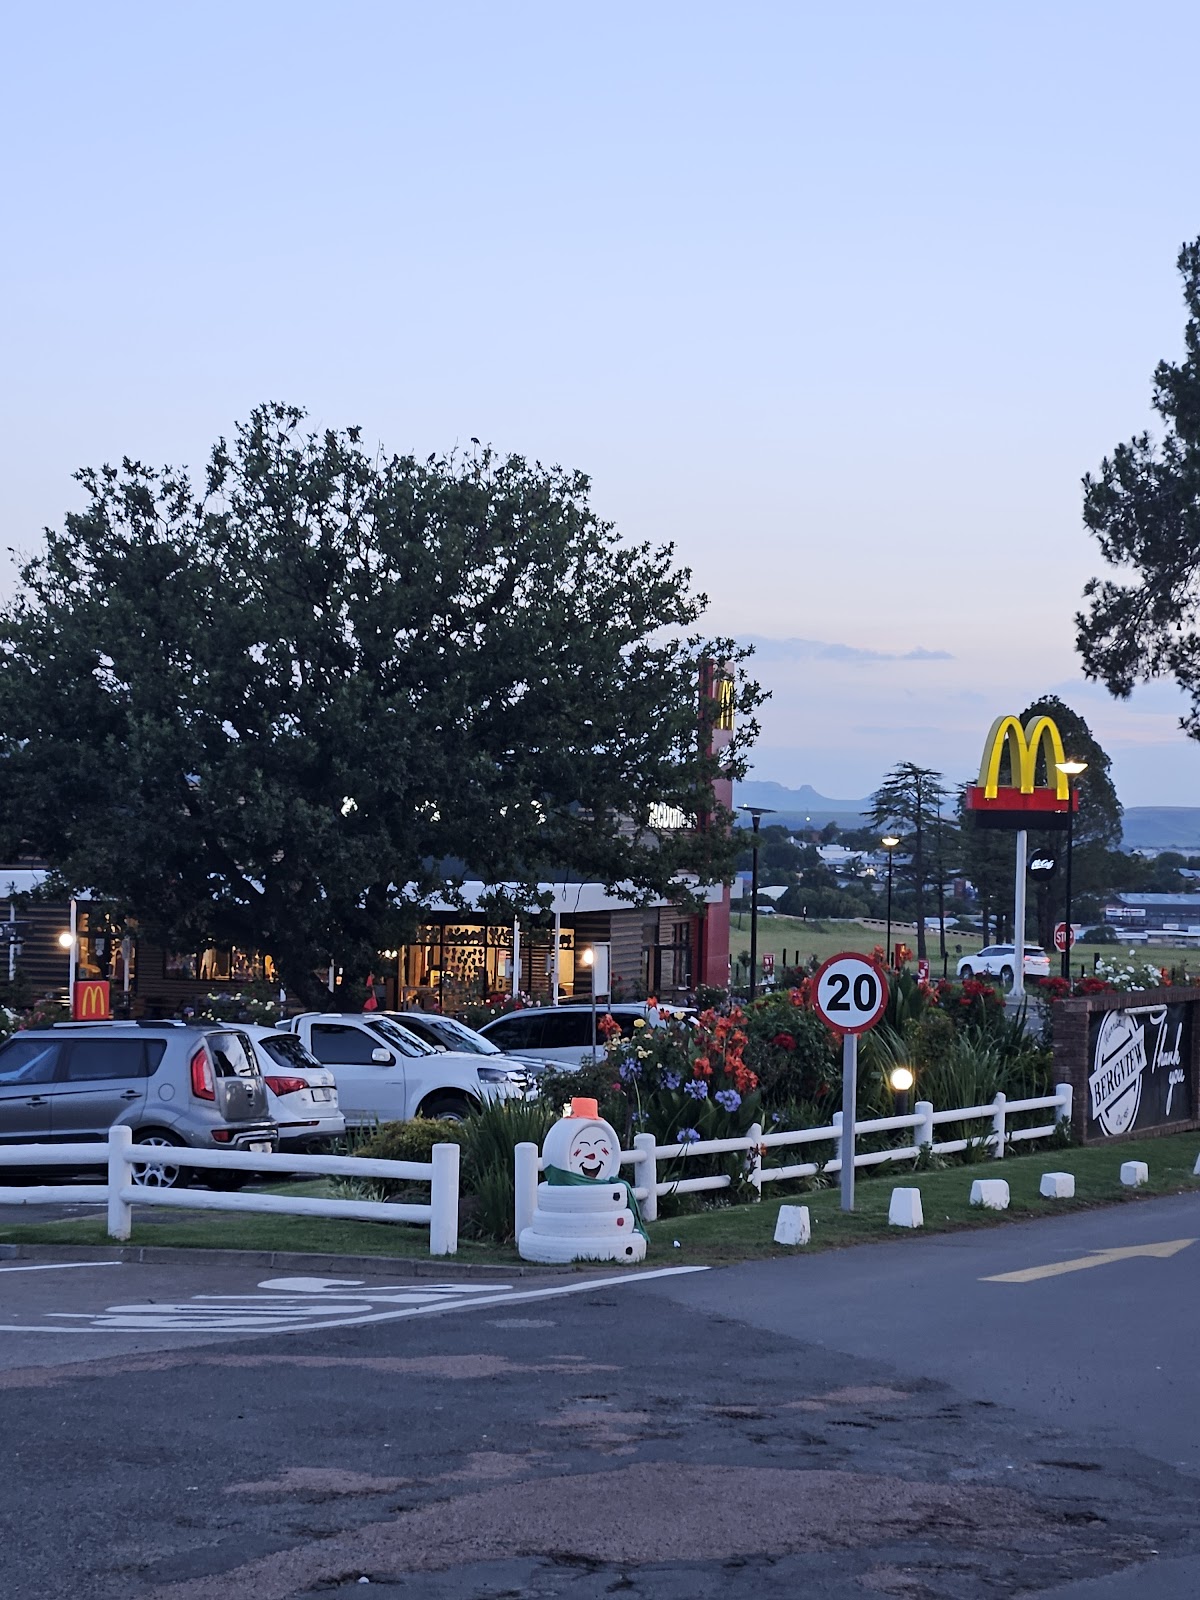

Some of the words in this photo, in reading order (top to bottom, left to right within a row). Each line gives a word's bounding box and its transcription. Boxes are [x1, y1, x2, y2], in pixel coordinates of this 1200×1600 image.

[1057, 931, 1073, 943] STP
[826, 974, 878, 1012] 20
[1093, 1039, 1143, 1108] BERGVIEW
[1168, 1067, 1186, 1118] you
